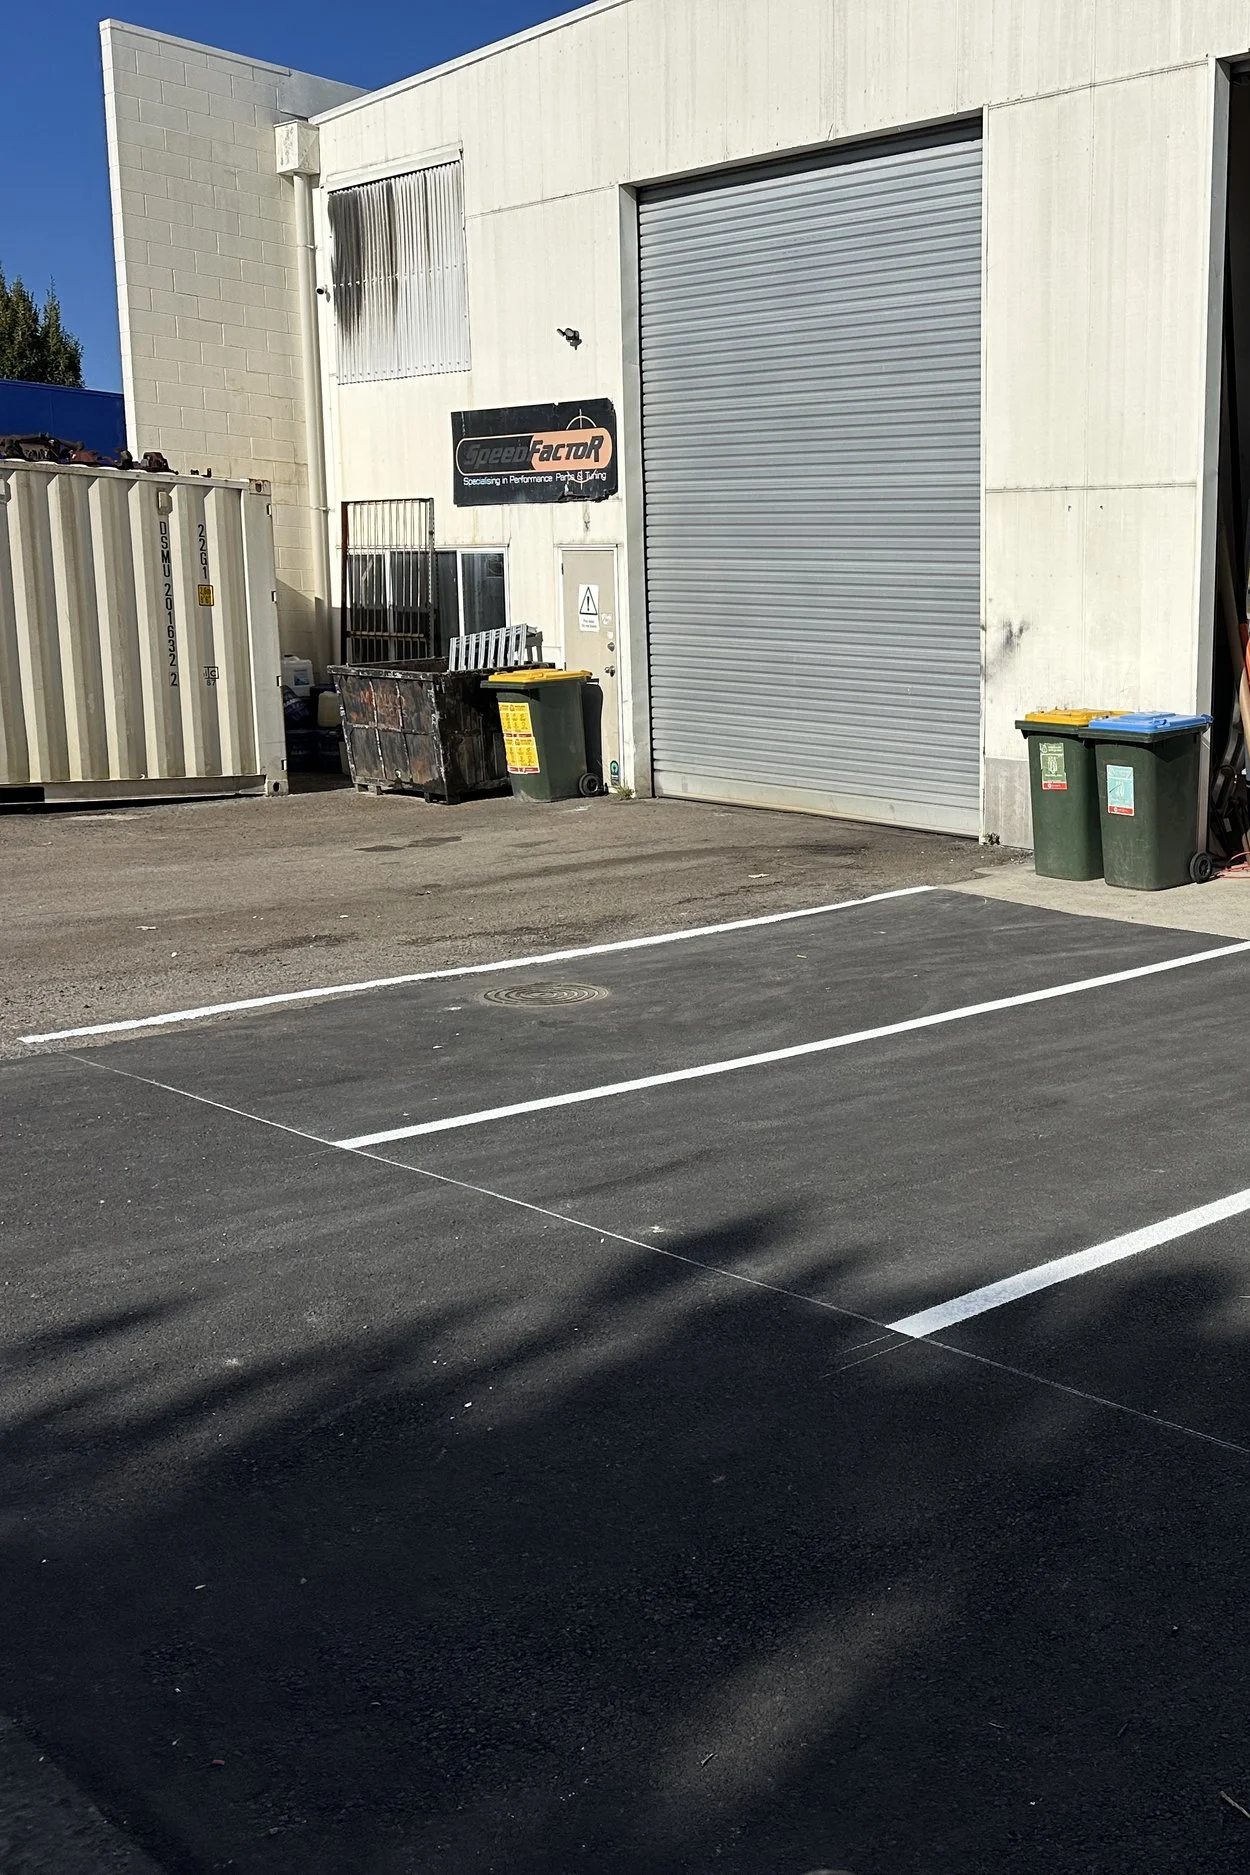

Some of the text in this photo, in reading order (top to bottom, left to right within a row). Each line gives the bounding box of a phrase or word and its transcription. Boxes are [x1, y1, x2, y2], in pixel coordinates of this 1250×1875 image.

[463, 476, 501, 487] Specialising
[501, 475, 509, 485] in
[509, 474, 553, 484] Performance
[555, 472, 575, 482] Parts
[160, 521, 171, 578] DSMU
[197, 523, 208, 579] 22G1
[164, 582, 177, 667] 201632
